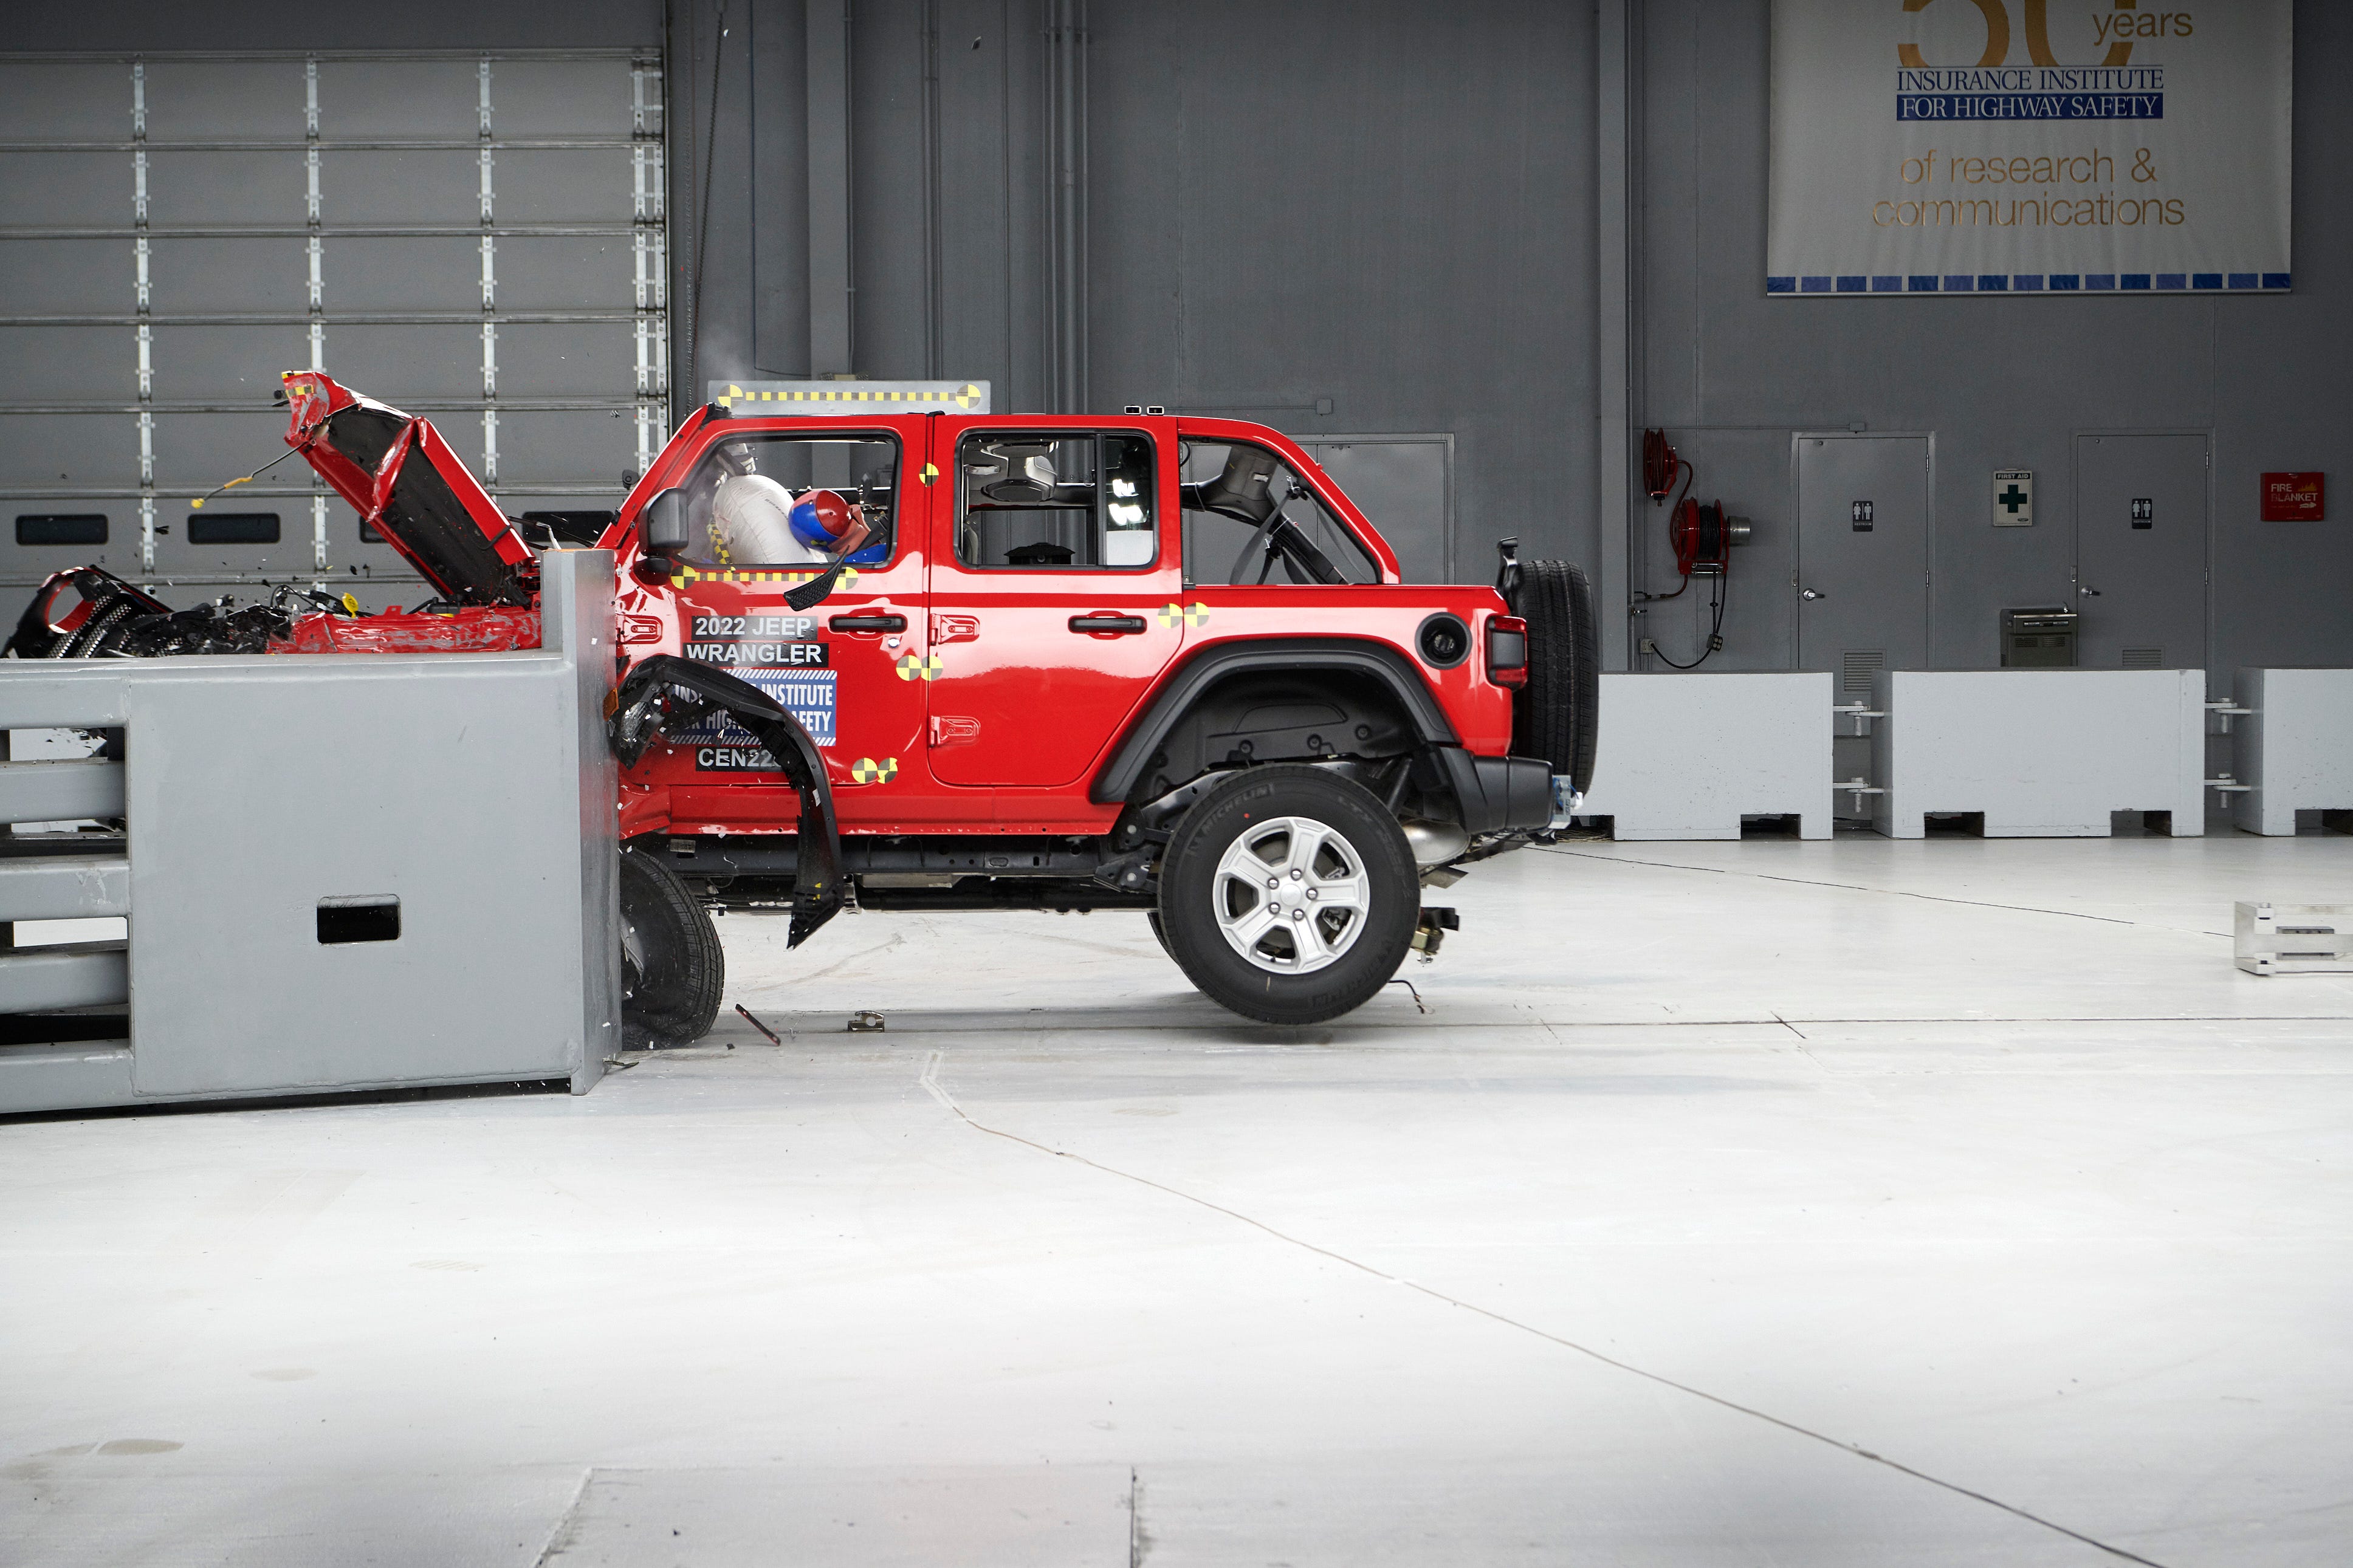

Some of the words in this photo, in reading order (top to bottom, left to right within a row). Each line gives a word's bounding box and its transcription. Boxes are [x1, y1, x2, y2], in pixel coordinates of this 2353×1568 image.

[2093, 12, 2193, 46] years
[1897, 69, 2032, 91] INSURANCE
[2039, 68, 2165, 89] INSTITUTE
[1902, 97, 1947, 118] FOR
[1954, 96, 2065, 117] HIGHWAY
[2071, 95, 2157, 117] SAFETY
[1900, 149, 1937, 185] of
[1951, 148, 2115, 184] research
[2131, 148, 2157, 183] &
[1872, 191, 2185, 227] communications
[2270, 483, 2292, 492] FIRE
[2271, 493, 2318, 502] BLANKET
[695, 618, 745, 636] 2022
[752, 617, 811, 636] JEEP
[686, 644, 822, 663] WRANGLER
[698, 748, 782, 767] CEN22
